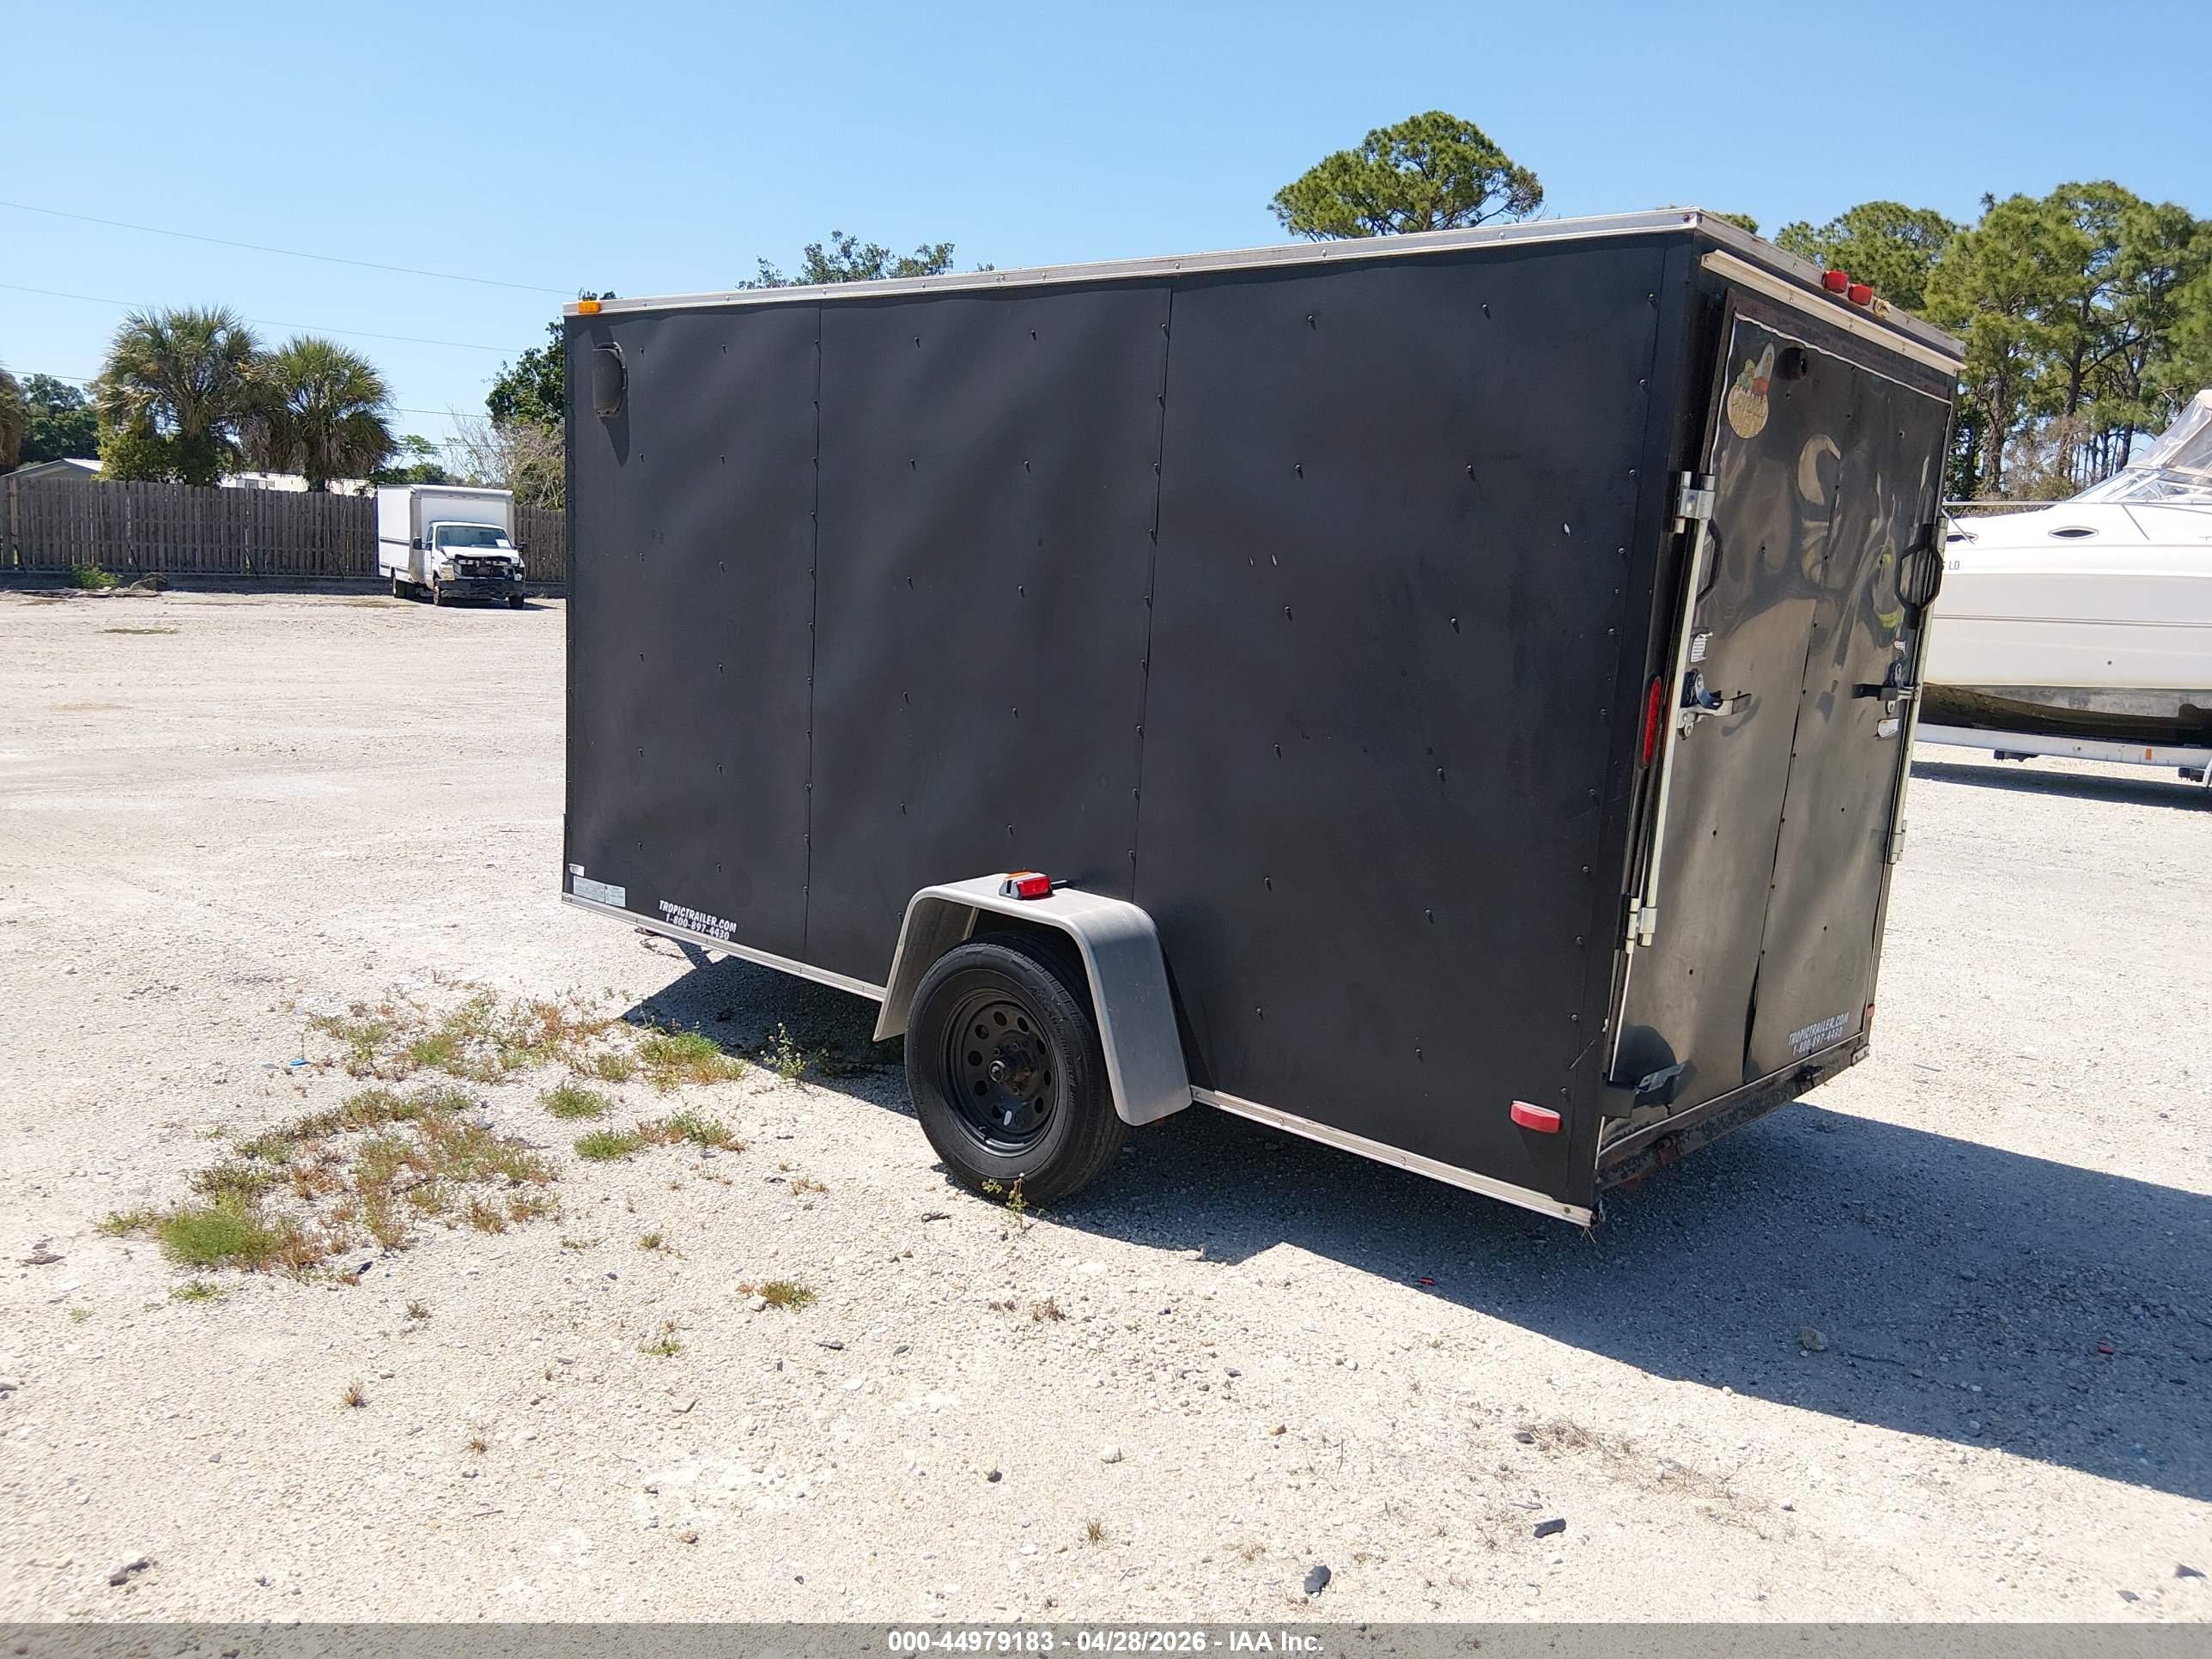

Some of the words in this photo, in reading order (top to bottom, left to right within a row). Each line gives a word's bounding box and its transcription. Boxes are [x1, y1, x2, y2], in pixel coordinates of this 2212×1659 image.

[659, 899, 738, 933] TROPICTRAILER.COM
[665, 913, 731, 940] 1-800-897-4430
[1789, 1011, 1850, 1046] TROPICTRAILER.COM
